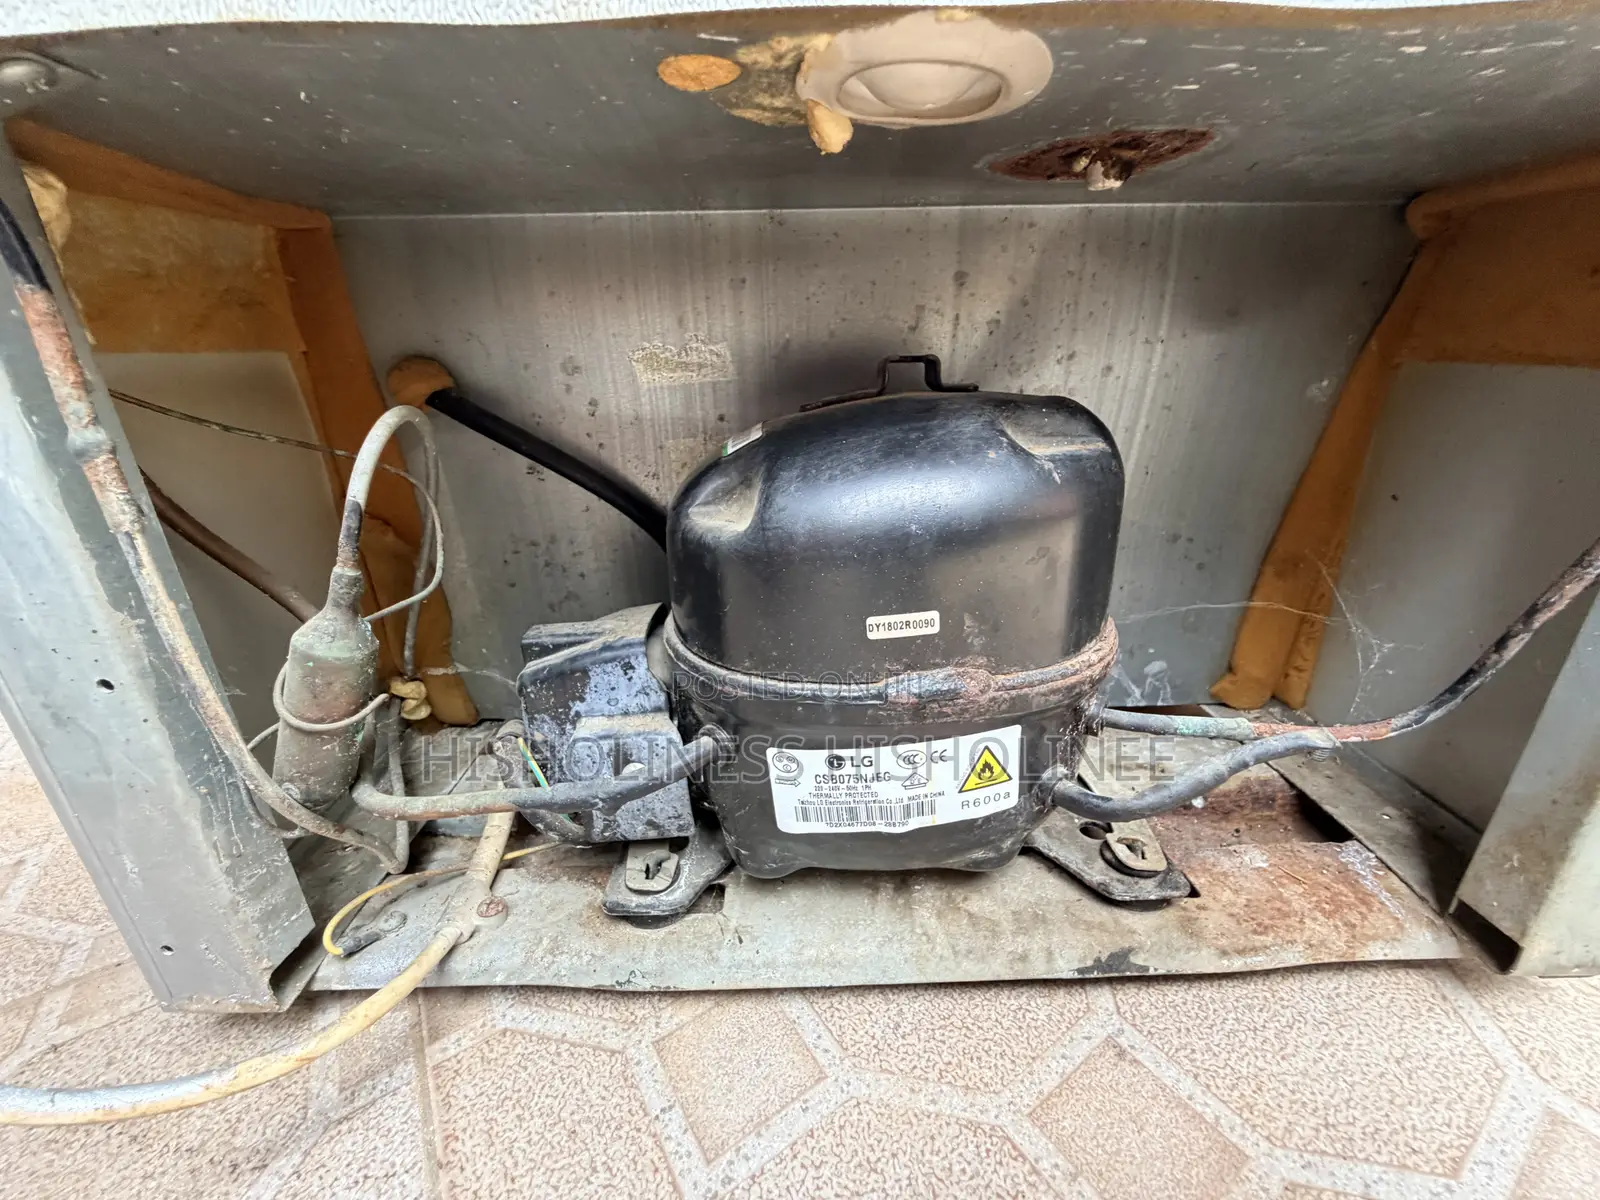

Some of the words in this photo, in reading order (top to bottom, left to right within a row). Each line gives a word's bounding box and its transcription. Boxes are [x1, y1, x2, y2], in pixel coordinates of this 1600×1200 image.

[868, 618, 935, 633] DY1802R0090
[850, 755, 874, 768] LG
[814, 772, 891, 785] CSB075NJEG
[809, 792, 843, 800] THERMALLY
[845, 791, 879, 799] PROTECTED
[907, 794, 922, 802] MADE
[930, 790, 945, 798] CHINA
[961, 791, 1011, 810] R600a
